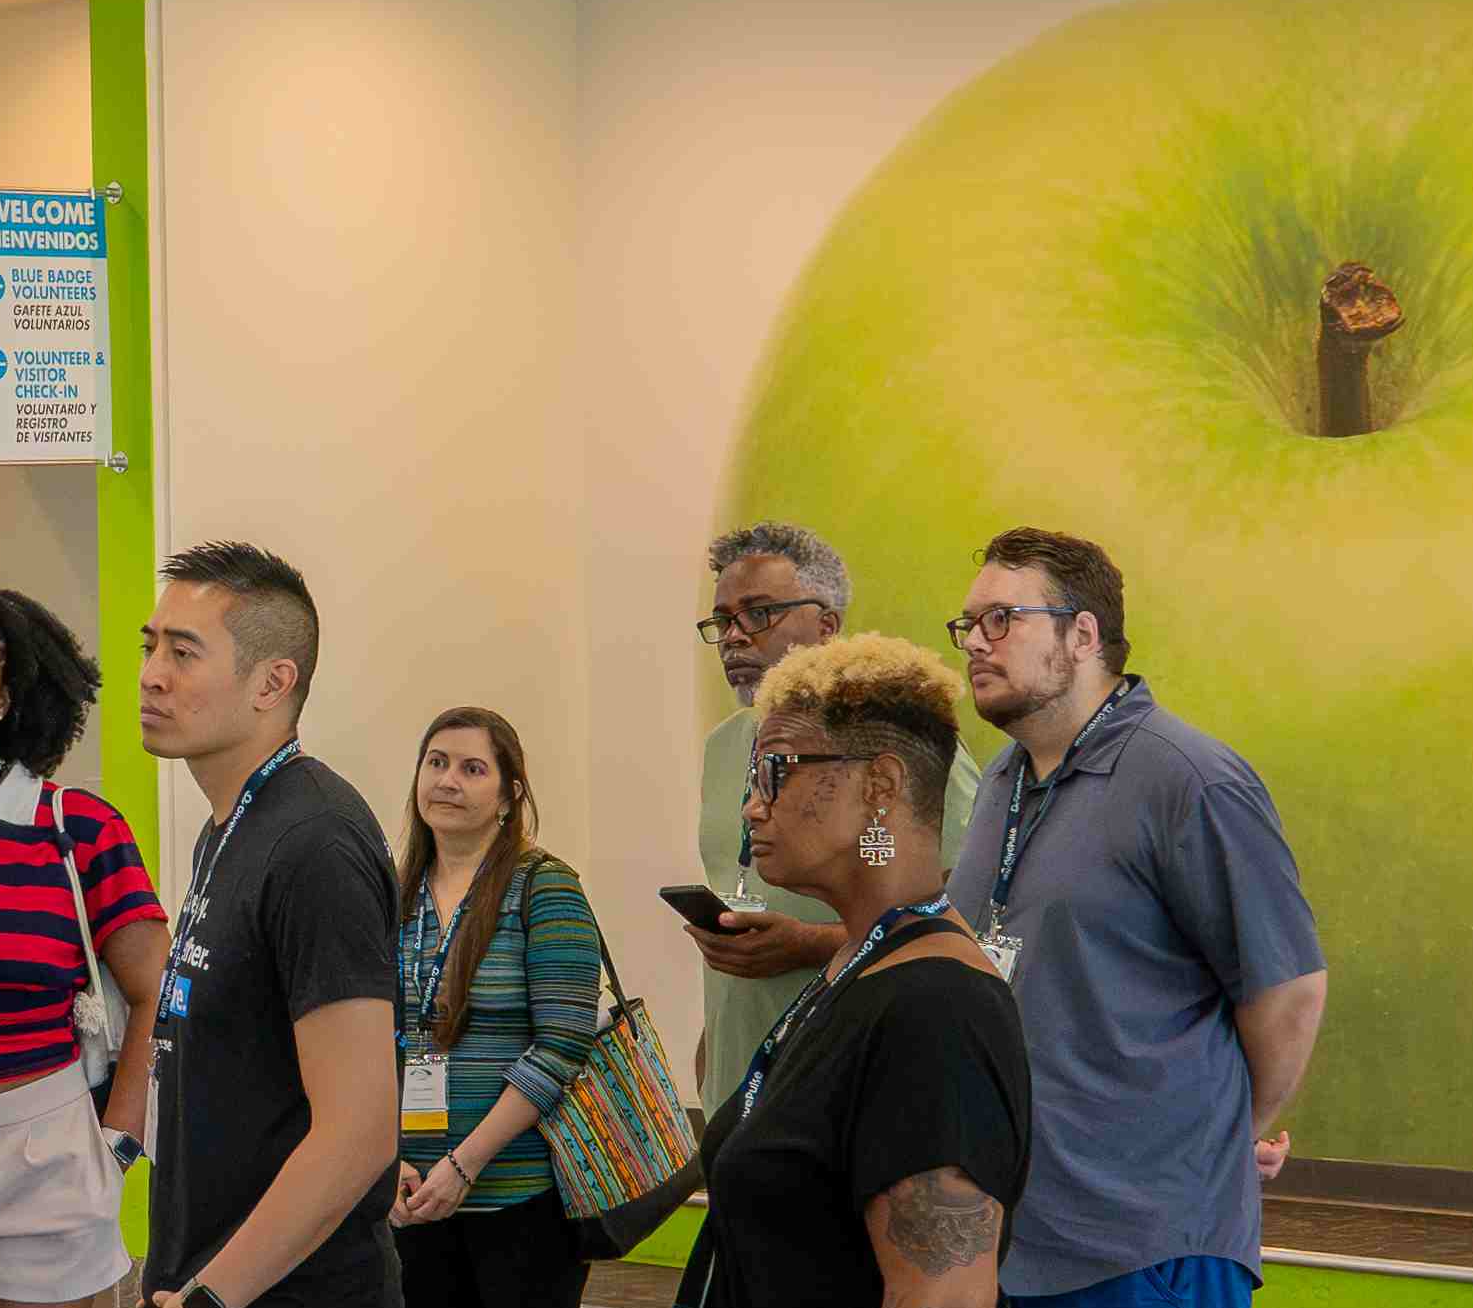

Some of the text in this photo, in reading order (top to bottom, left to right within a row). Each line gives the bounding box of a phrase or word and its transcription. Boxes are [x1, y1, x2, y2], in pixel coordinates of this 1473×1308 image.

[11, 268, 93, 284] BLUE BADGE
[12, 285, 97, 301] VOLUNTEERS
[13, 304, 84, 318] GAFETE AZUL
[13, 318, 91, 331] VOLUNTARIOS
[14, 351, 105, 366] VOLUNTEER &
[15, 368, 67, 382] VISITOR
[15, 385, 79, 399] CHECK-IN
[16, 403, 97, 416] VOLUNTARIO Y
[16, 417, 68, 430] REGISTRO
[16, 431, 93, 443] DE VISITANTES
